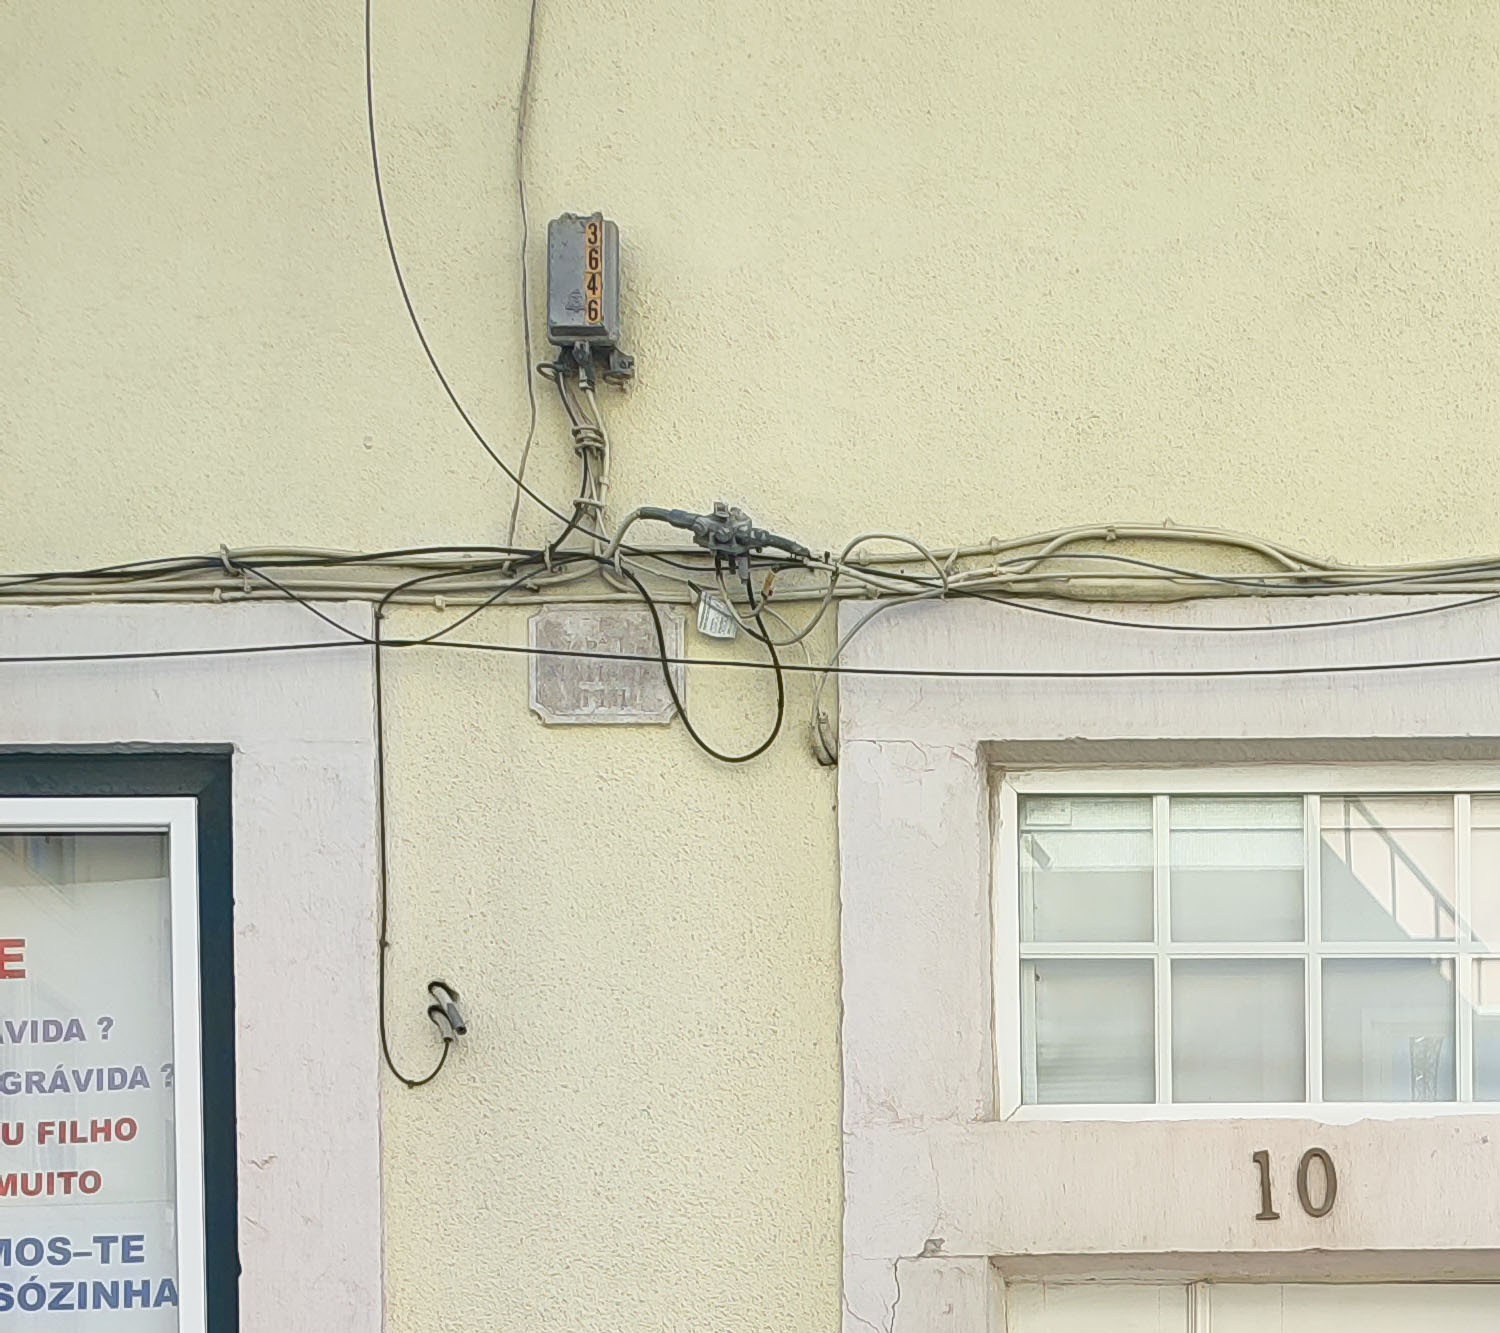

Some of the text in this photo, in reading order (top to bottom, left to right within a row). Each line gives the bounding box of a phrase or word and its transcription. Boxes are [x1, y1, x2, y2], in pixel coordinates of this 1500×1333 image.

[587, 222, 599, 322] 3646
[0, 1018, 87, 1044] VIDA
[0, 1064, 151, 1095] GRÁVIDA
[38, 1117, 138, 1145] FILHO
[0, 1170, 102, 1197] MUITO
[1252, 1147, 1338, 1221] 10
[0, 1274, 178, 1312] SÓZINHA
